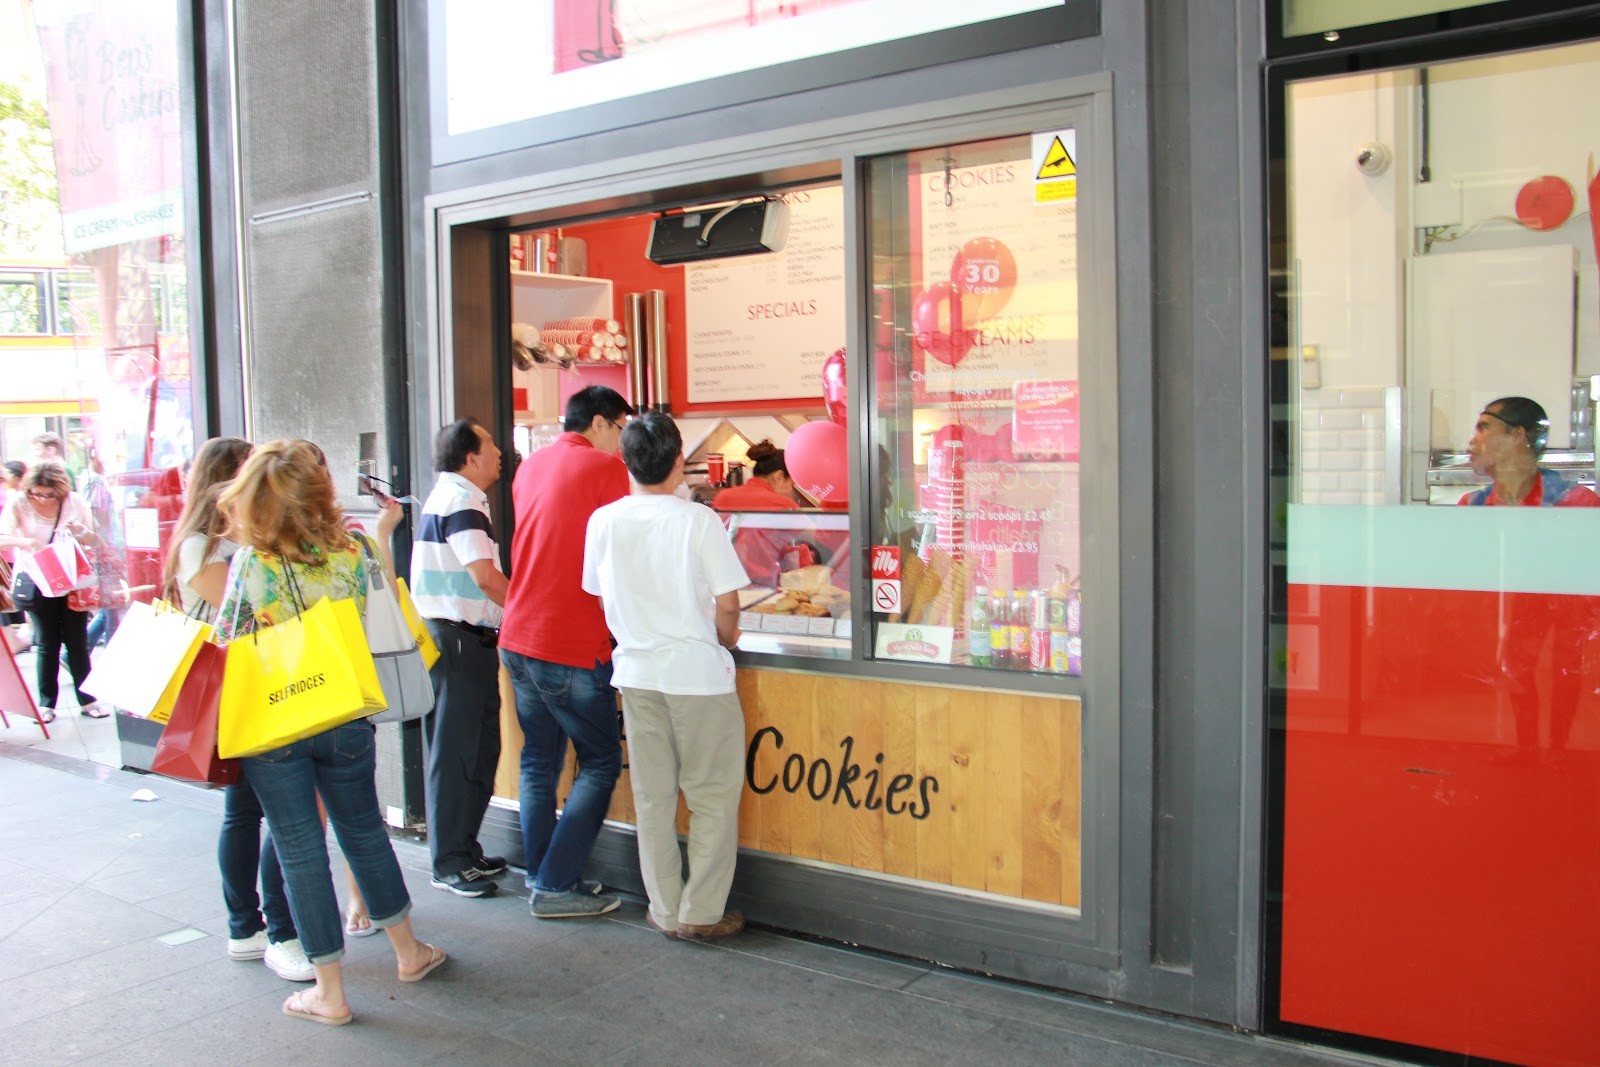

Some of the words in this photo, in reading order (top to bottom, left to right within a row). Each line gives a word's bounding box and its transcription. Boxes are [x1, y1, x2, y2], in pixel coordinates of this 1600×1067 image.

[929, 165, 1014, 192] COOKIES
[965, 264, 1000, 283] 30
[965, 284, 999, 295] Years
[747, 299, 817, 320] SPECIALS
[956, 385, 993, 396] flavours
[988, 511, 1022, 524] scoops
[959, 540, 1009, 553] milkshakes
[1012, 540, 1039, 553] £2.95
[873, 550, 899, 577] illy
[269, 673, 326, 706] SELFRIDGES
[746, 726, 940, 820] Cookies
